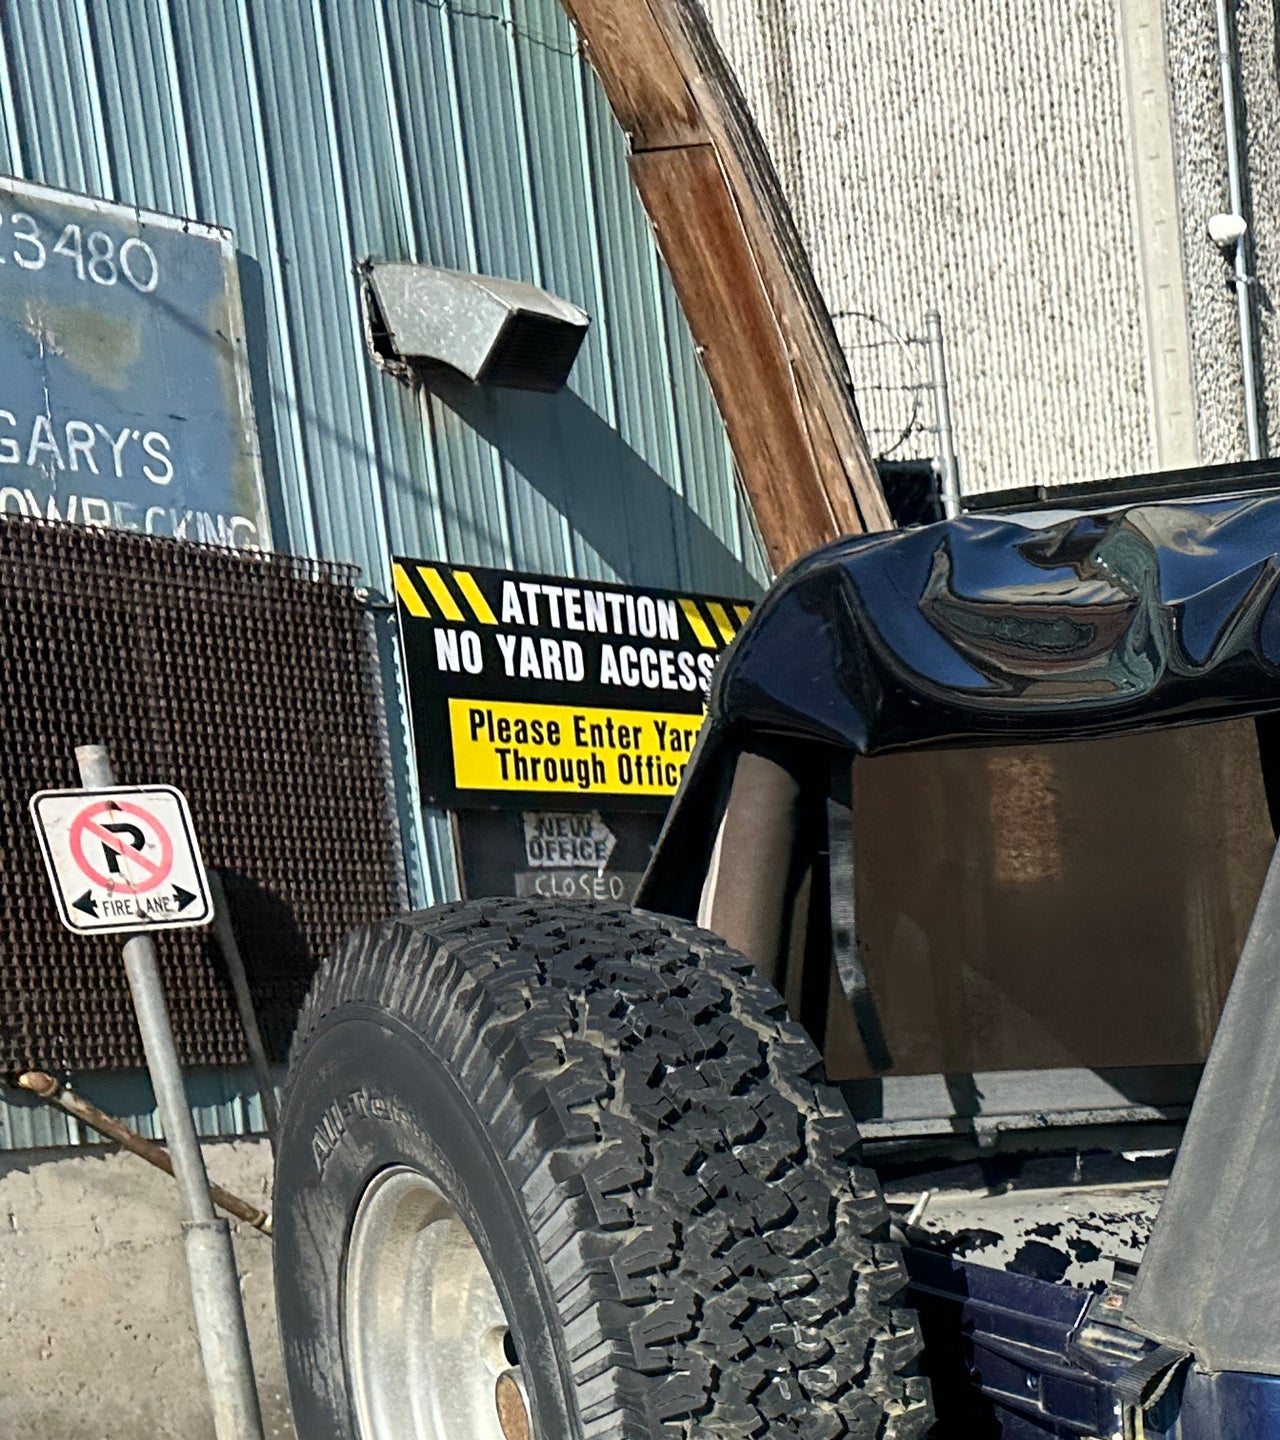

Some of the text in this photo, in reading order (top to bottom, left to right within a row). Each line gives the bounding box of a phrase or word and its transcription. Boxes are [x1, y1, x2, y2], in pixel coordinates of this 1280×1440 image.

[0, 213, 158, 293] 3480
[0, 409, 174, 485] GARY'S
[501, 580, 680, 641] ATTENTION
[433, 627, 720, 696] NO YARD ACCESS
[469, 708, 700, 753] Please Enter Yar
[495, 748, 687, 789] Through Offic
[537, 816, 592, 838] NEW
[528, 836, 608, 862] OFFICE
[102, 896, 172, 917] FIRE ANE
[535, 873, 624, 900] CLOSED
